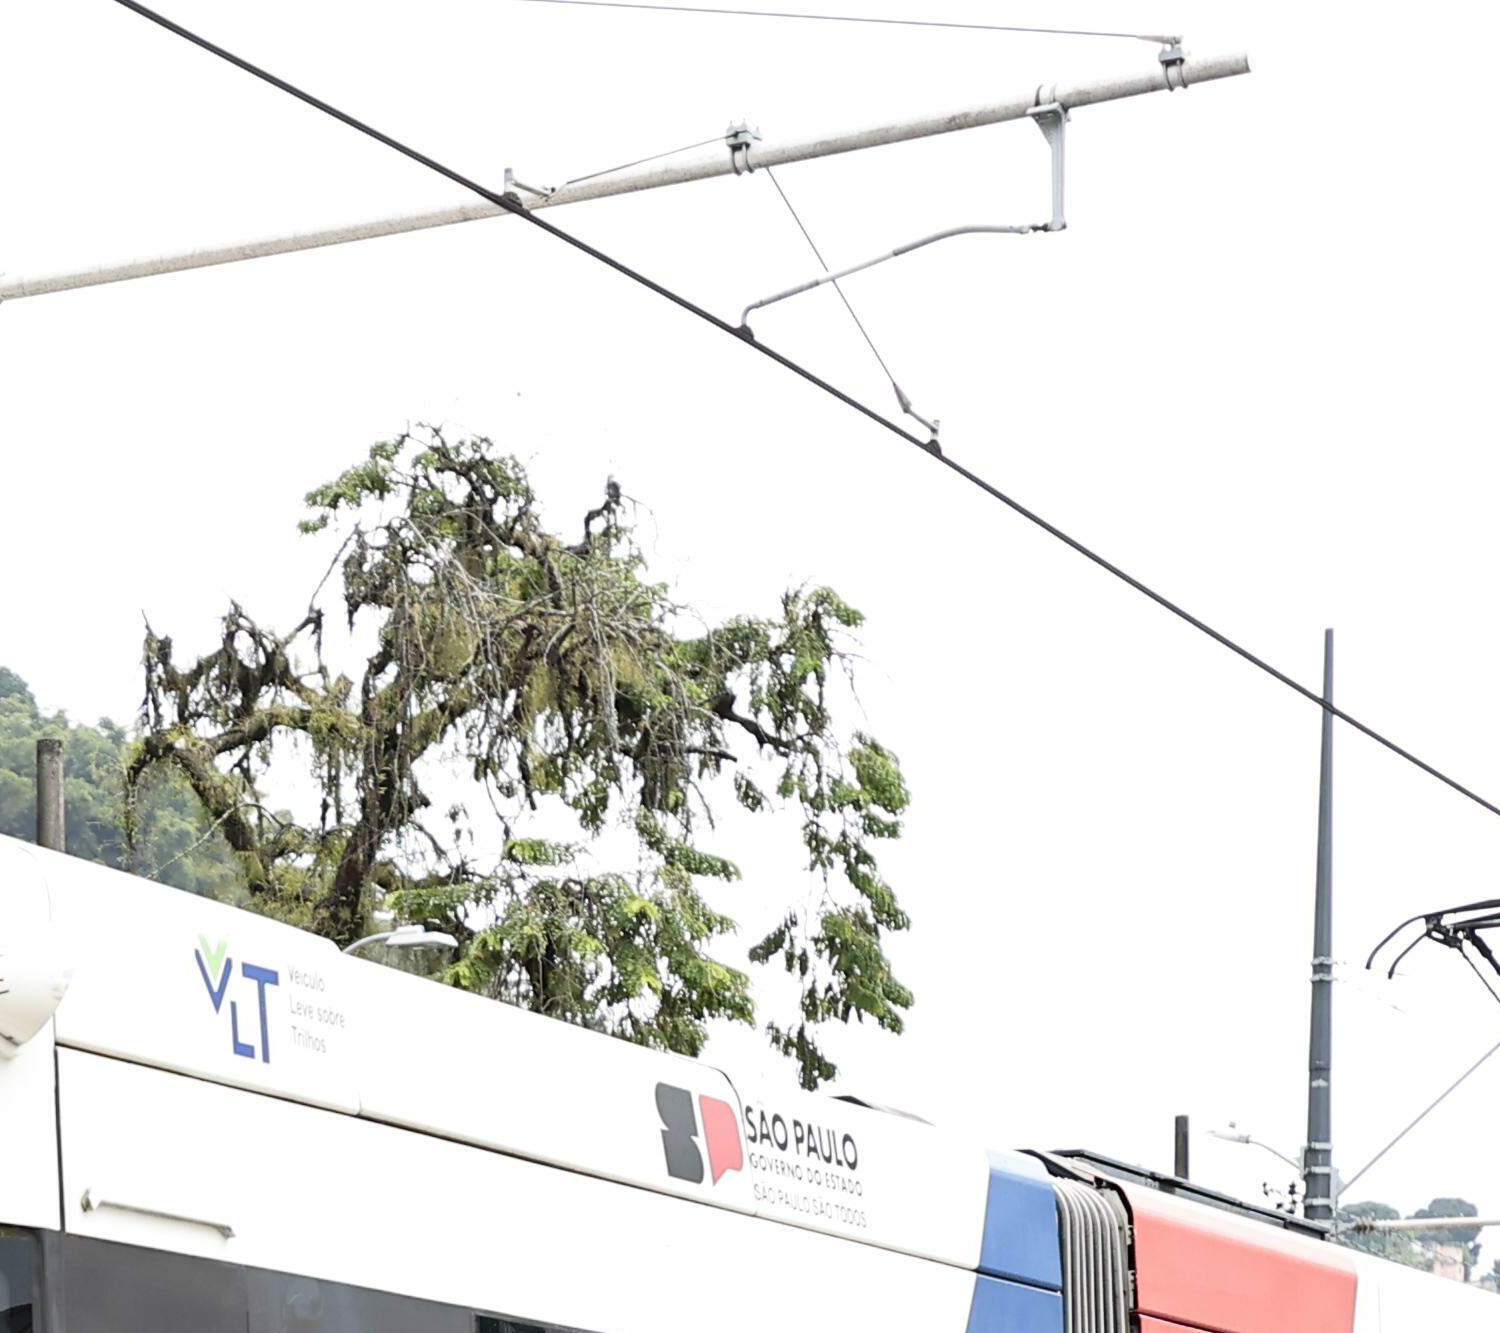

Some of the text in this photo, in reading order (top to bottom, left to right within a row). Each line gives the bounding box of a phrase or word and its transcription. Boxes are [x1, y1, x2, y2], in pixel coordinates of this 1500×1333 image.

[289, 994, 345, 1028] Leve sobre
[291, 1025, 327, 1053] Trilhos
[792, 1118, 859, 1172] PAULO
[749, 1152, 863, 1197] GOVERNO DO ESTADO
[778, 1189, 810, 1214] PAULO
[834, 1204, 867, 1228] TODOS
